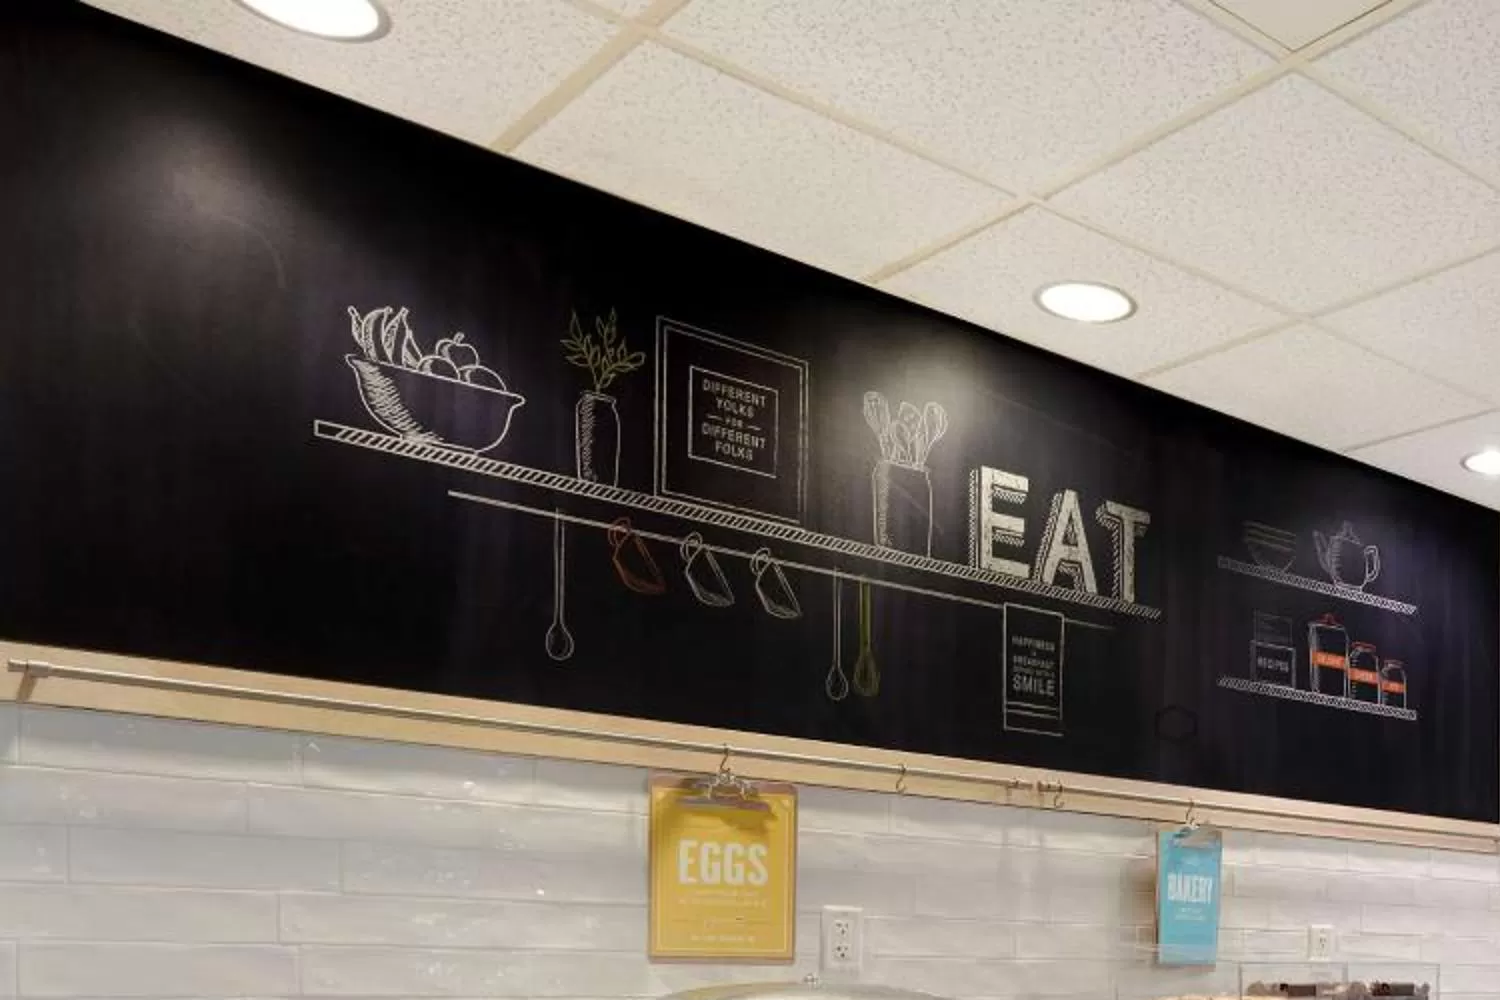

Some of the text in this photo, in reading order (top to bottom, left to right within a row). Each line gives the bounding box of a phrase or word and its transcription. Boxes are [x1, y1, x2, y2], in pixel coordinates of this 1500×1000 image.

[702, 378, 766, 409] DIFFERENT
[716, 396, 755, 419] YOLKS
[701, 421, 767, 449] DIFFERENT
[715, 440, 753, 462] FOLKS
[968, 465, 1151, 603] EAT
[1012, 673, 1056, 697] SMILE
[678, 838, 769, 886] EGGS
[1167, 873, 1213, 904] BAKERY
